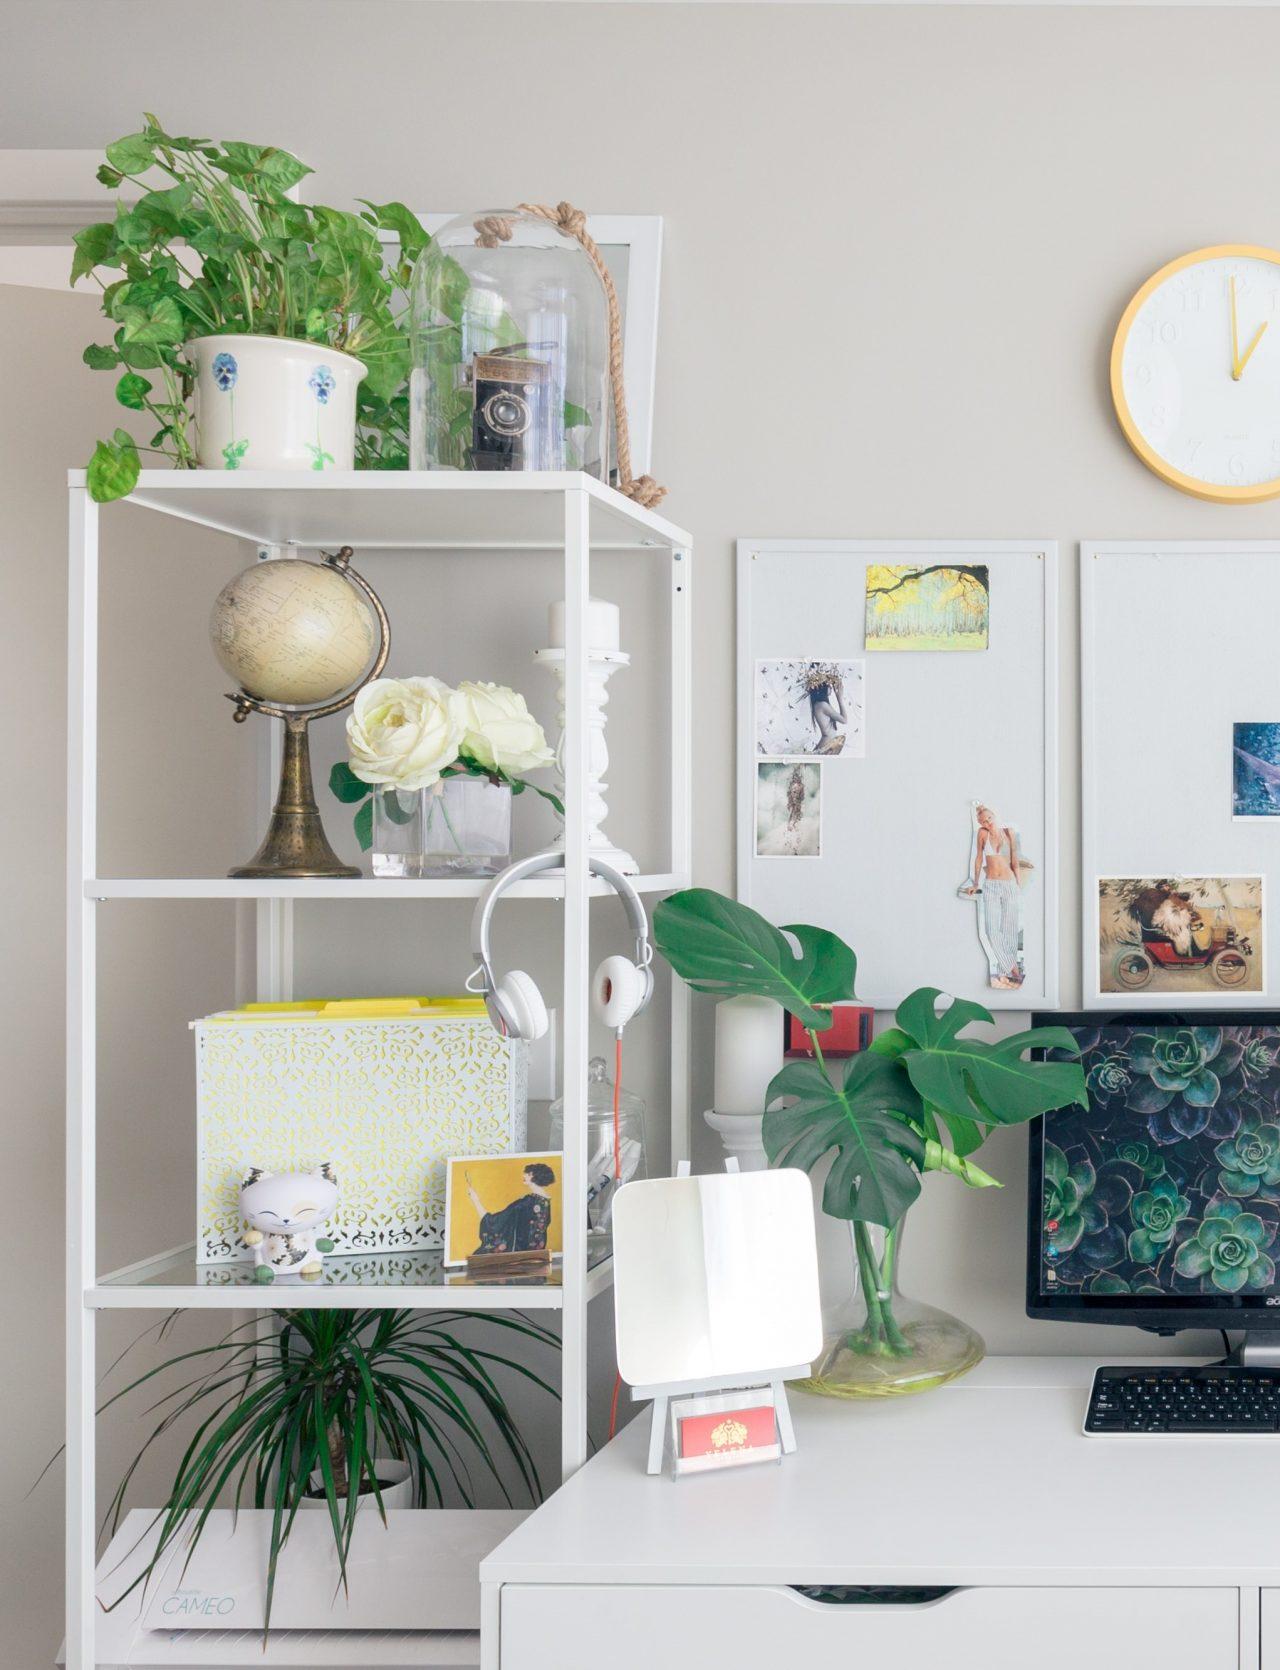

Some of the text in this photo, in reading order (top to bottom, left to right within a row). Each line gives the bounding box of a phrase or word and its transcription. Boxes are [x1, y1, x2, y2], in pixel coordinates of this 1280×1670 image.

[1180, 287, 1202, 313] 11
[1149, 319, 1178, 345] 10
[1135, 362, 1153, 386] 9
[1150, 402, 1167, 428] 8
[1187, 438, 1204, 463] 7
[1227, 453, 1245, 478] 6
[162, 1596, 235, 1615] CAMEO
